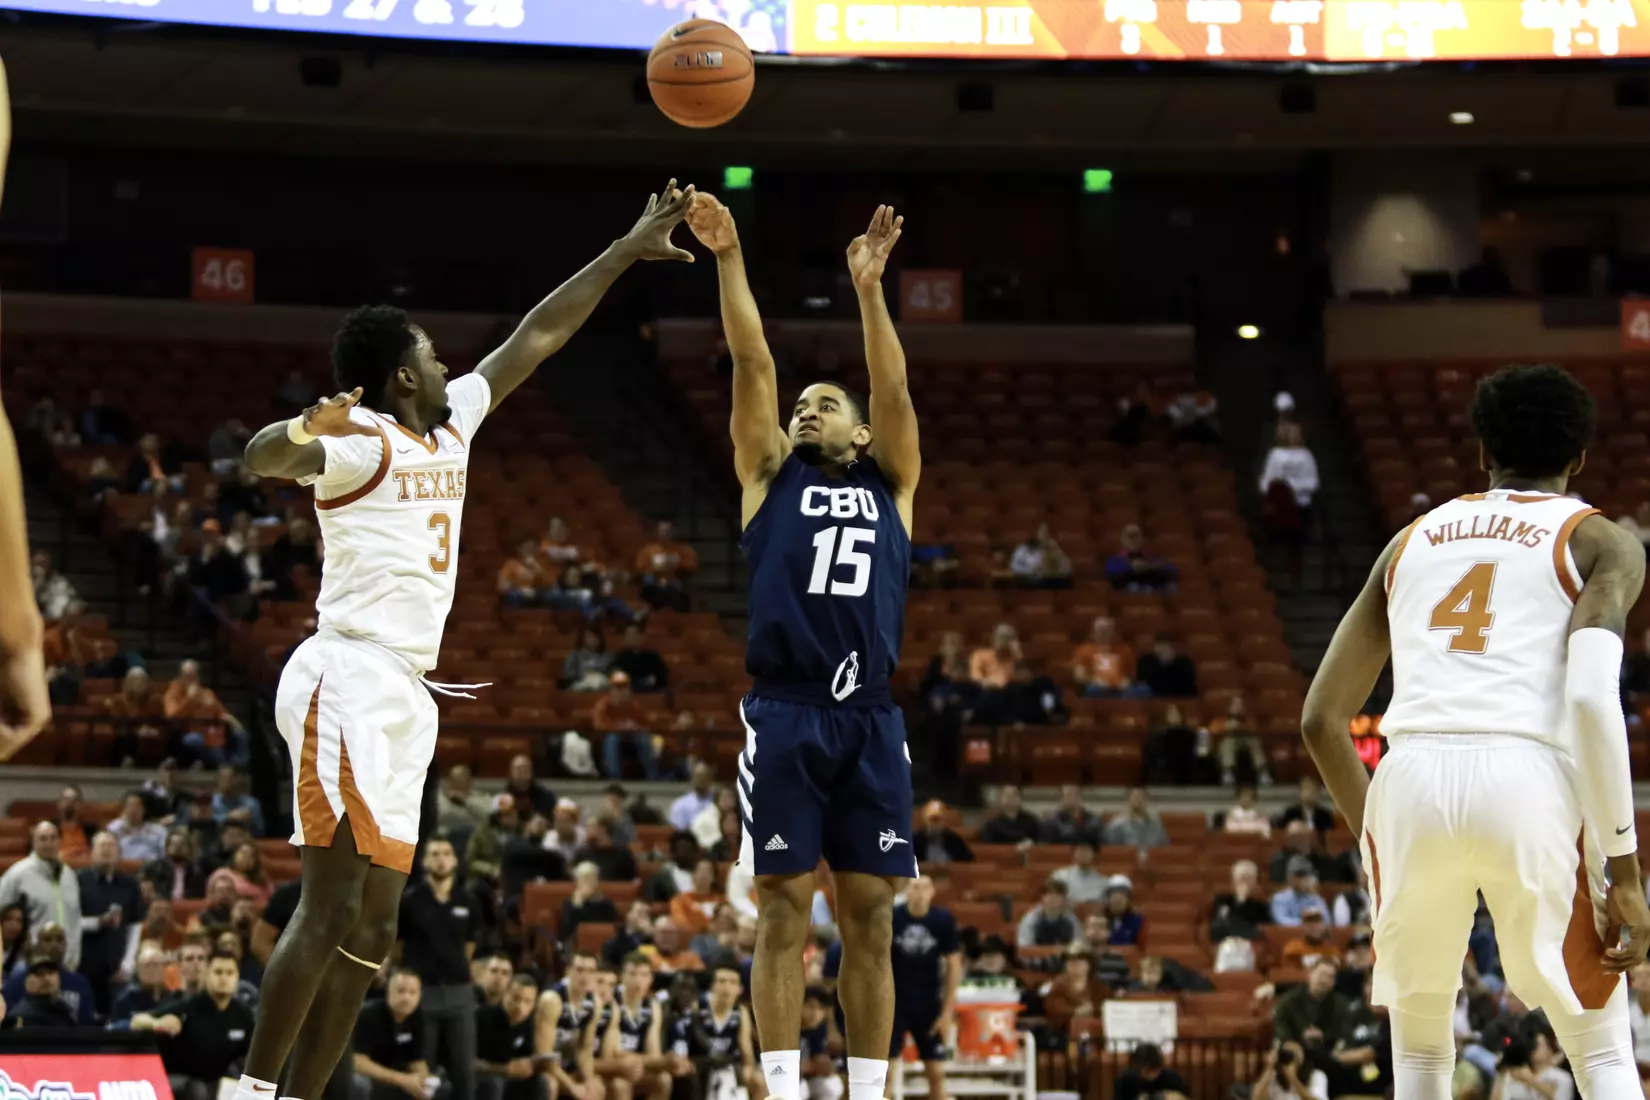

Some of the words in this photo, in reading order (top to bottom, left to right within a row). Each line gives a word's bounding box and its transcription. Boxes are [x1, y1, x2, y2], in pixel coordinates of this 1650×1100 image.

[201, 259, 246, 291] 46
[393, 468, 466, 502] TEXAS
[800, 485, 879, 521] CBU
[427, 511, 451, 574] 3
[1424, 514, 1551, 548] WILLIAMS
[807, 526, 876, 597] 15
[1428, 561, 1498, 654] 4
